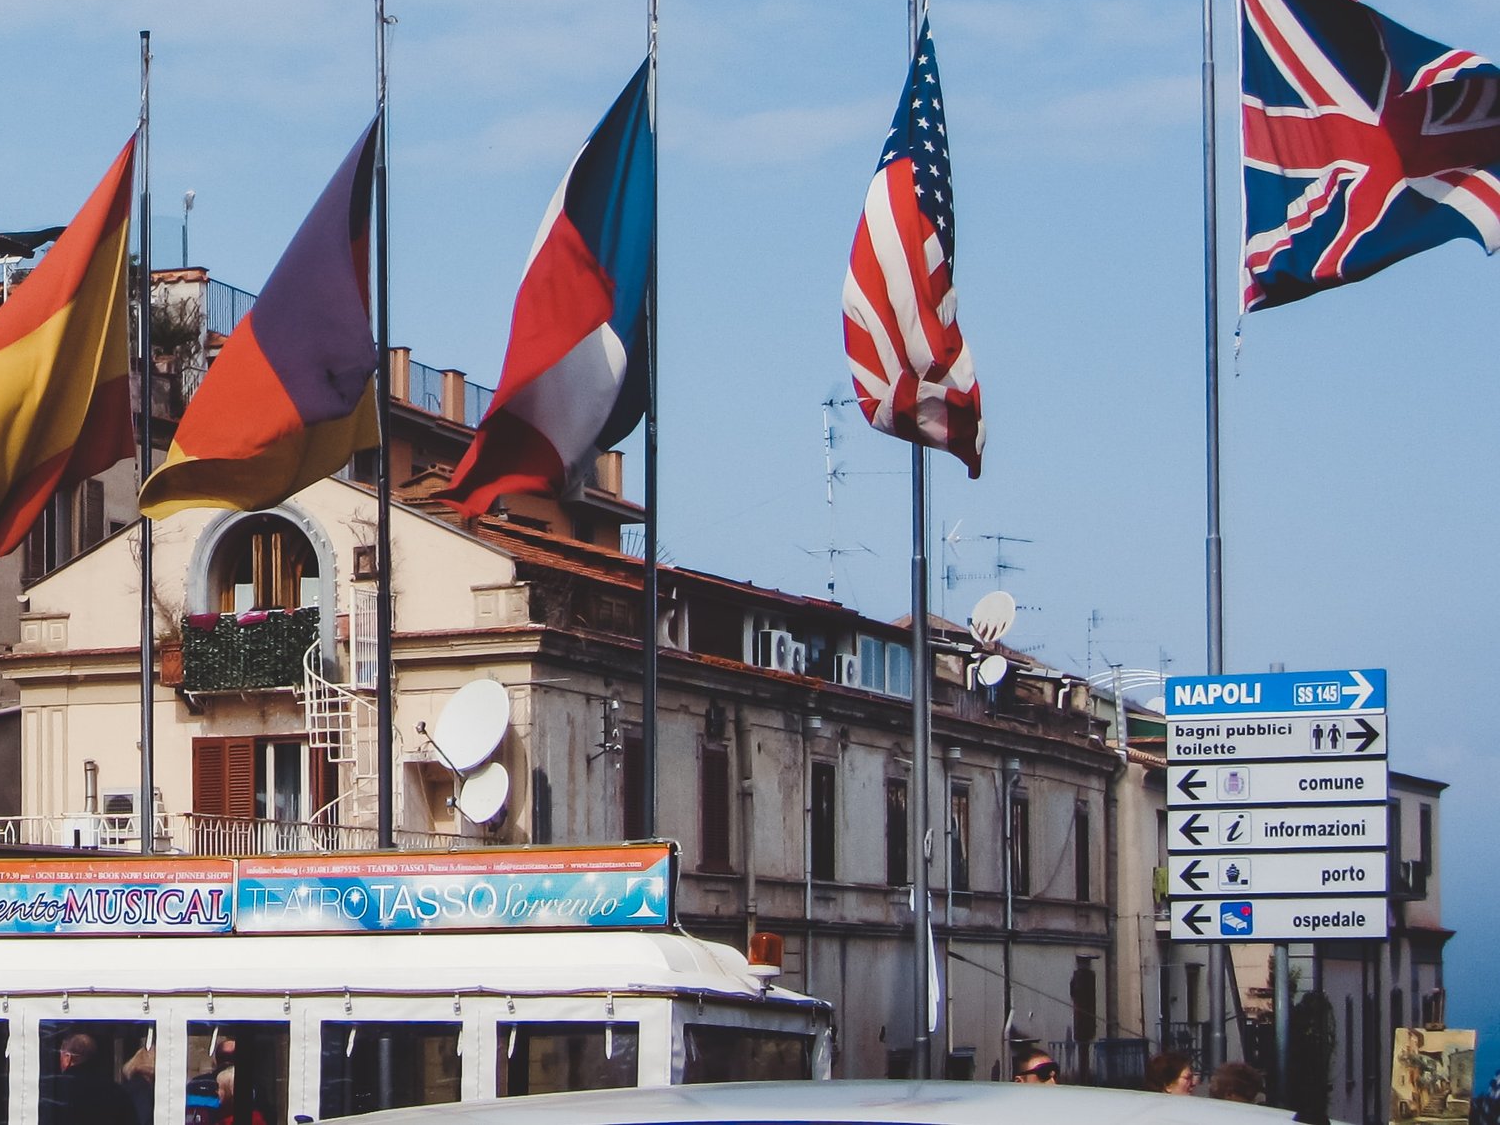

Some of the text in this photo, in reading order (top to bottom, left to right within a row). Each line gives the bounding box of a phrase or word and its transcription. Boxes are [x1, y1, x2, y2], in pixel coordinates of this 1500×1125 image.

[1174, 683, 1338, 706] NAPOLI SS 145
[1175, 723, 1293, 739] bagni pubblici
[1175, 743, 1237, 755] toilette
[1298, 775, 1364, 792] comune
[1264, 820, 1367, 838] informazioni
[35, 871, 55, 880] OGNI
[56, 871, 74, 880] SERA
[98, 871, 120, 880] BOOK
[121, 871, 142, 880] NOW!
[143, 871, 166, 880] SHOW
[175, 871, 205, 880] DINNER
[205, 871, 231, 880] SHOW
[367, 864, 398, 873] TEATRO
[1321, 866, 1366, 886] porto
[61, 887, 230, 926] MUSICAL
[245, 882, 623, 921] TEATRO TASSO Sorrento
[1293, 910, 1366, 930] ospedale
